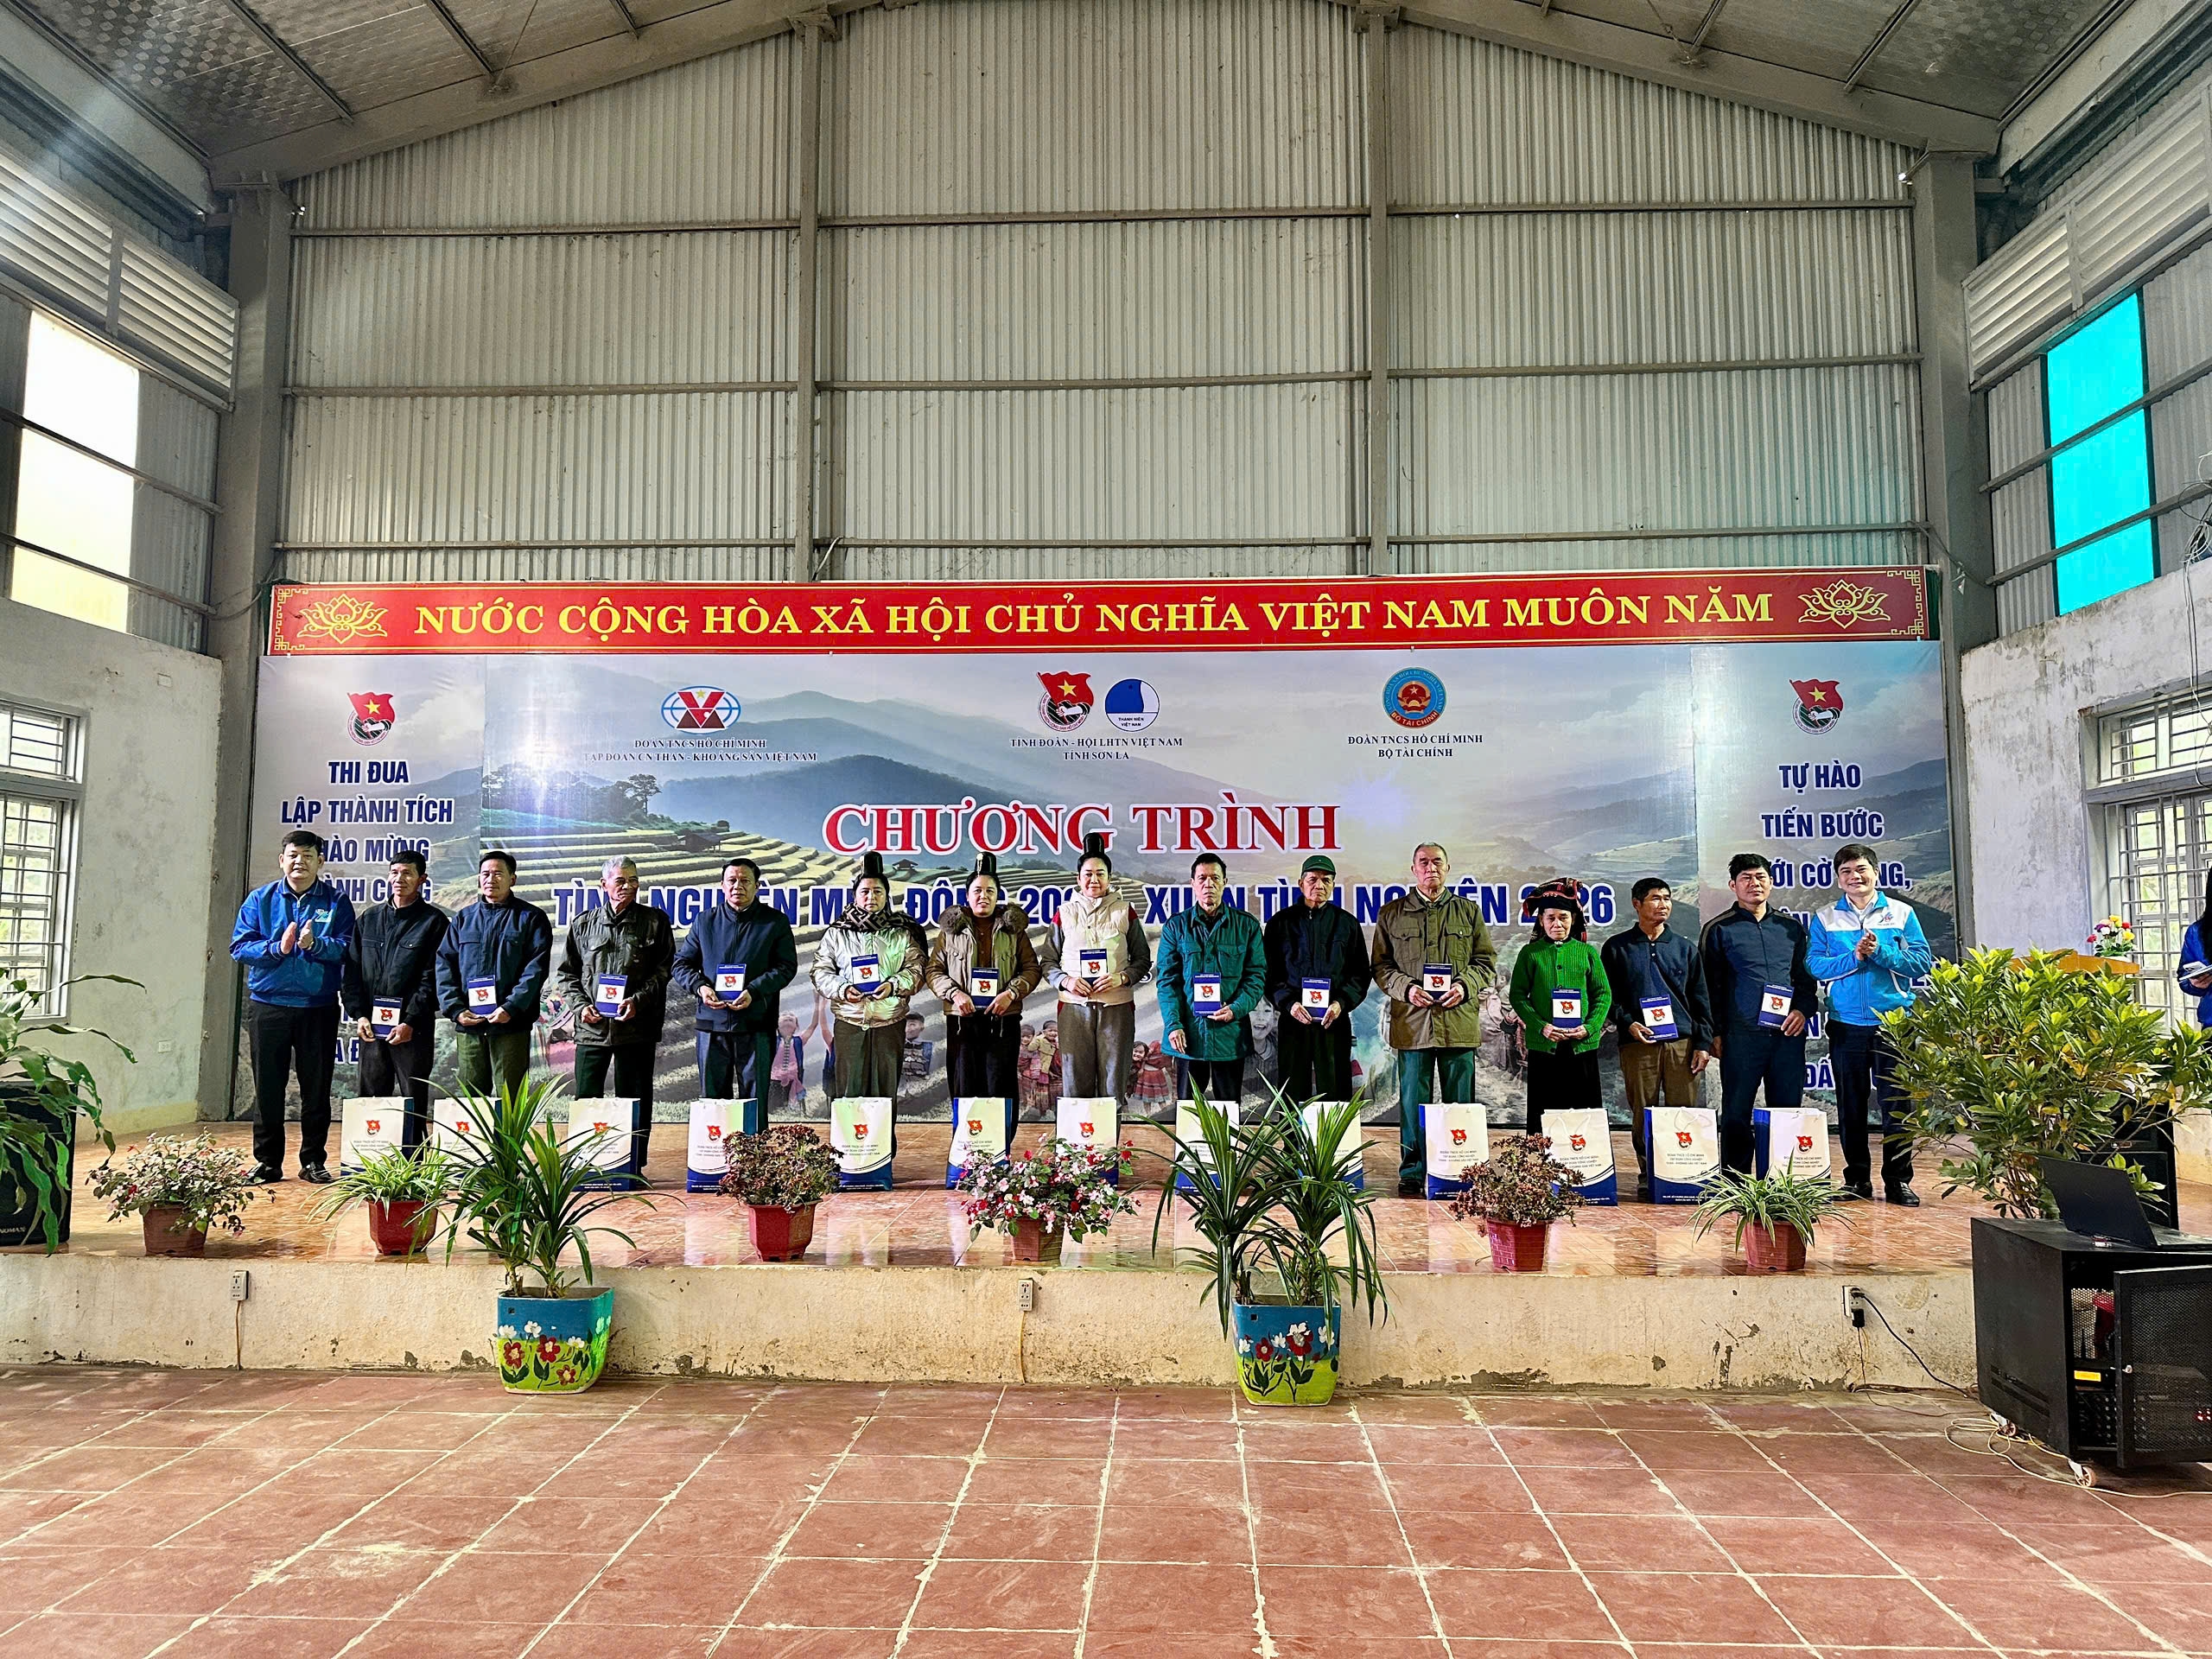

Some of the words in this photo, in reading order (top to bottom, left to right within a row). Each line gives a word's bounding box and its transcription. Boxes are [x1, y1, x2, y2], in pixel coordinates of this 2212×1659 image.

[414, 597, 545, 634] NƯỚC
[559, 597, 690, 641] CỘNG
[702, 597, 803, 633] HÒA
[809, 598, 874, 633] XÃ
[886, 597, 971, 641] HỘI
[984, 593, 1084, 633] CHỦ
[1096, 596, 1249, 633] NGHĨA
[1259, 594, 1370, 638] VIỆT
[1382, 601, 1491, 629] NAM
[1503, 588, 1651, 626] MUÔN
[1664, 585, 1774, 623] NĂM
[666, 740, 695, 748] TNCS
[715, 737, 735, 748] CHÍ
[737, 740, 766, 748] MINH
[1039, 736, 1069, 747] ĐOÀN
[1077, 737, 1096, 748] HỘI
[1099, 738, 1128, 747] LHTN
[1131, 736, 1155, 748] VIỆT
[1158, 738, 1183, 747] NAM
[1347, 734, 1379, 745] ĐOÀN
[1381, 735, 1409, 744] TNCS
[1430, 733, 1450, 744] CHÍ
[1452, 734, 1484, 743] MINH
[638, 753, 652, 761] CN
[656, 753, 684, 761] THAN
[765, 751, 790, 763] VIỆT
[792, 753, 817, 761] NAM
[1091, 751, 1113, 760] SƠN
[1378, 747, 1394, 759] BỘ
[1395, 747, 1414, 758] TÀI
[1416, 747, 1453, 757] CHÍNH
[328, 761, 360, 784] THI
[367, 761, 409, 784] ĐUA
[1779, 762, 1808, 793] TỰ
[1815, 760, 1861, 788] HÀO
[282, 796, 321, 828] LẬP
[328, 795, 398, 823] THÀNH
[405, 794, 454, 823] TÍCH
[825, 798, 1117, 852] CHƯƠNG
[1132, 790, 1342, 851] TRÌNH
[1762, 807, 1813, 838] TIẾN
[1821, 809, 1885, 838] BƯỚC
[1802, 857, 1834, 887] CỜ
[1522, 886, 1613, 924] 226
